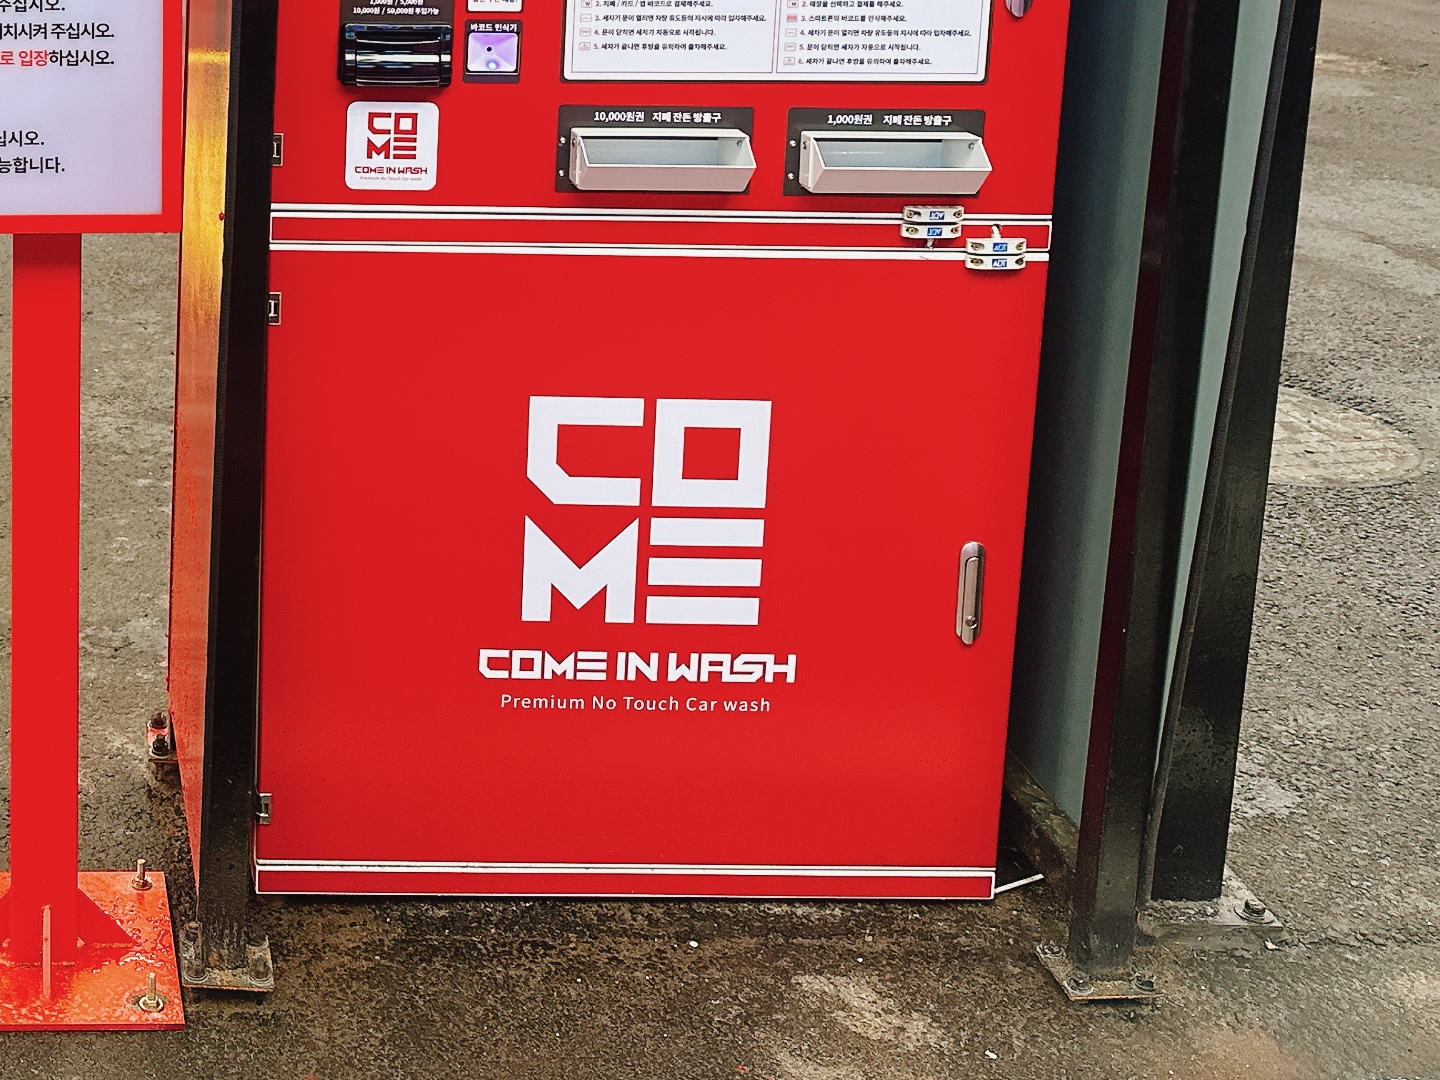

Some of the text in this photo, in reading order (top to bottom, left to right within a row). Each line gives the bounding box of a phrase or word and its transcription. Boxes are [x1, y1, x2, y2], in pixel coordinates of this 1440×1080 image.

[367, 112, 418, 135] CO
[594, 111, 721, 123] 10,000원권 지폐 잔돈 방출구
[828, 114, 952, 126] 1,000원권 지폐 잔돈 방출구
[367, 137, 417, 159] ME
[527, 396, 772, 508] CO
[521, 515, 764, 626] ME
[478, 648, 797, 683] COME IN WASH
[501, 694, 769, 712] Premium No Touch Car wash
